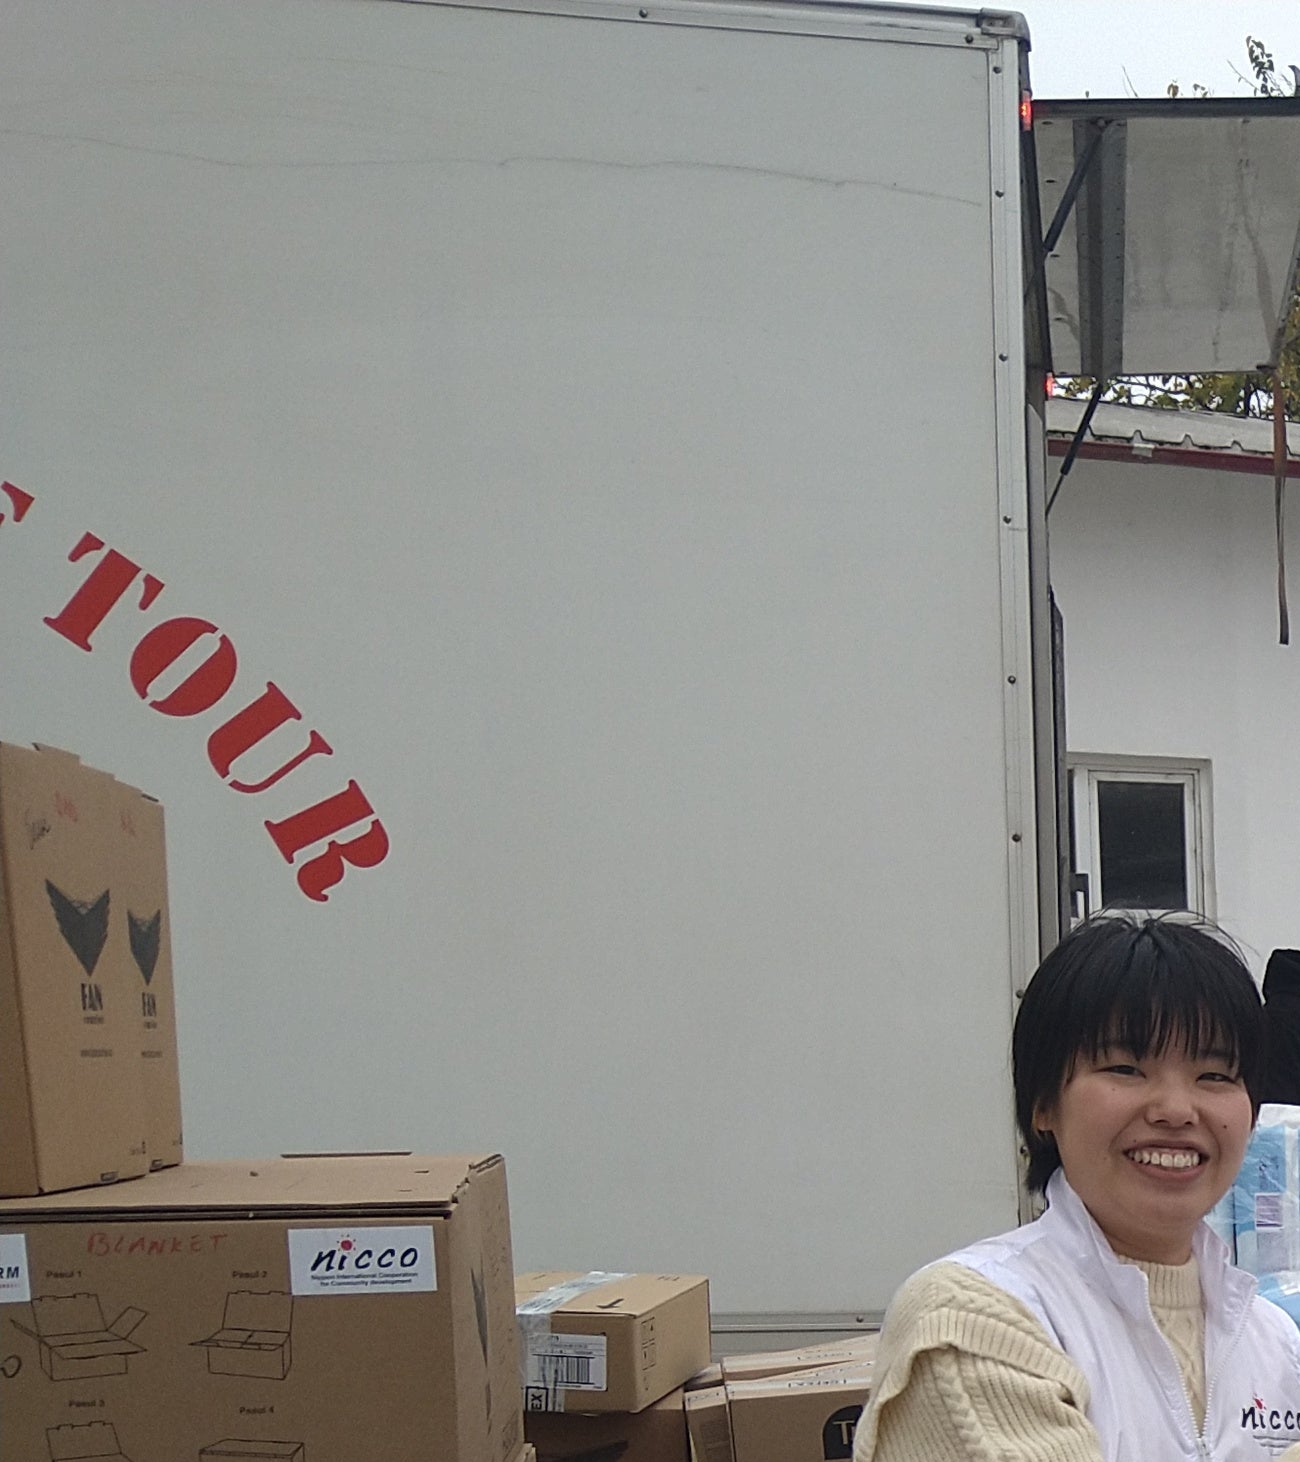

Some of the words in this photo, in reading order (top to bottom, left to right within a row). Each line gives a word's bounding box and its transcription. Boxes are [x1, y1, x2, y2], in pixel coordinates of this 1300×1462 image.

[43, 531, 391, 902] TOUR
[88, 1232, 228, 1257] BLANKET
[311, 1240, 419, 1272] nicco
